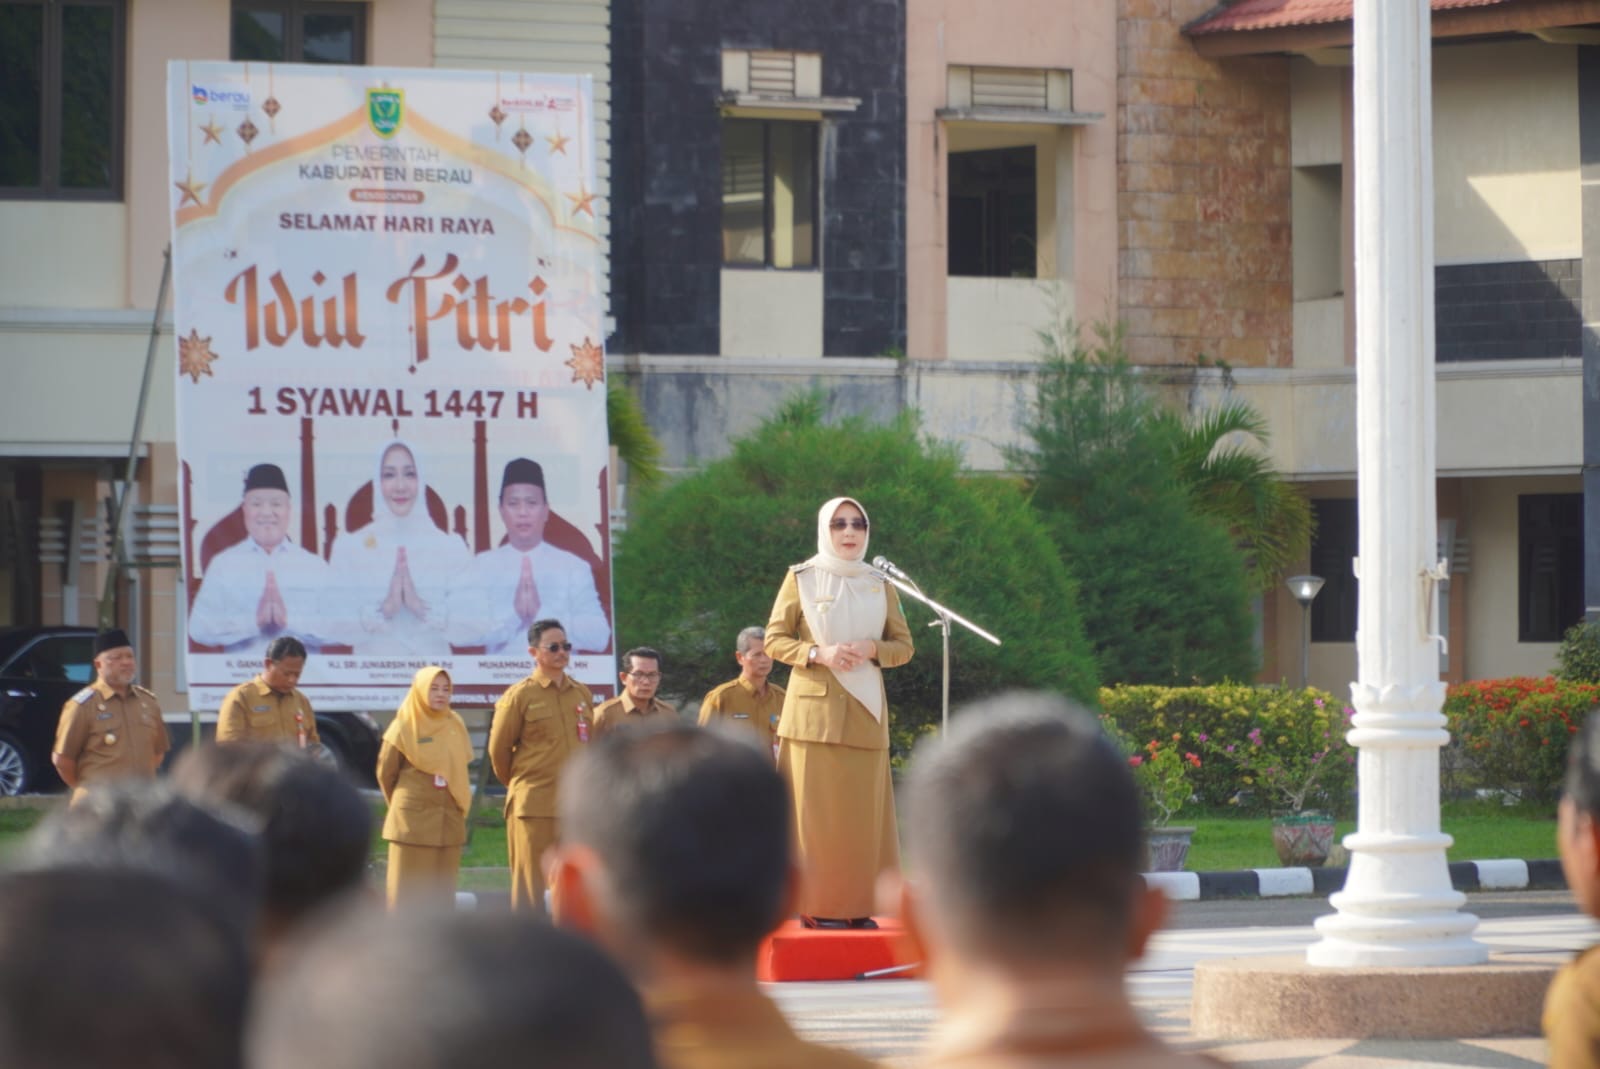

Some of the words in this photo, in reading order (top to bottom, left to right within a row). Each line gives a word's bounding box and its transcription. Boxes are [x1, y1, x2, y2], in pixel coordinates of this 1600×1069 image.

[332, 145, 440, 162] PEMERINTAH
[299, 164, 406, 181] KABUPATEN
[413, 168, 472, 184] BERAU
[279, 213, 377, 231] SELAMAT
[384, 216, 434, 232] HARI
[440, 218, 495, 234] RAYA
[224, 264, 366, 352] Idul
[386, 253, 555, 363] Fitri
[247, 386, 267, 415] 1
[276, 387, 413, 417] SYAWAL
[423, 389, 505, 418] 1447
[517, 391, 538, 418] H
